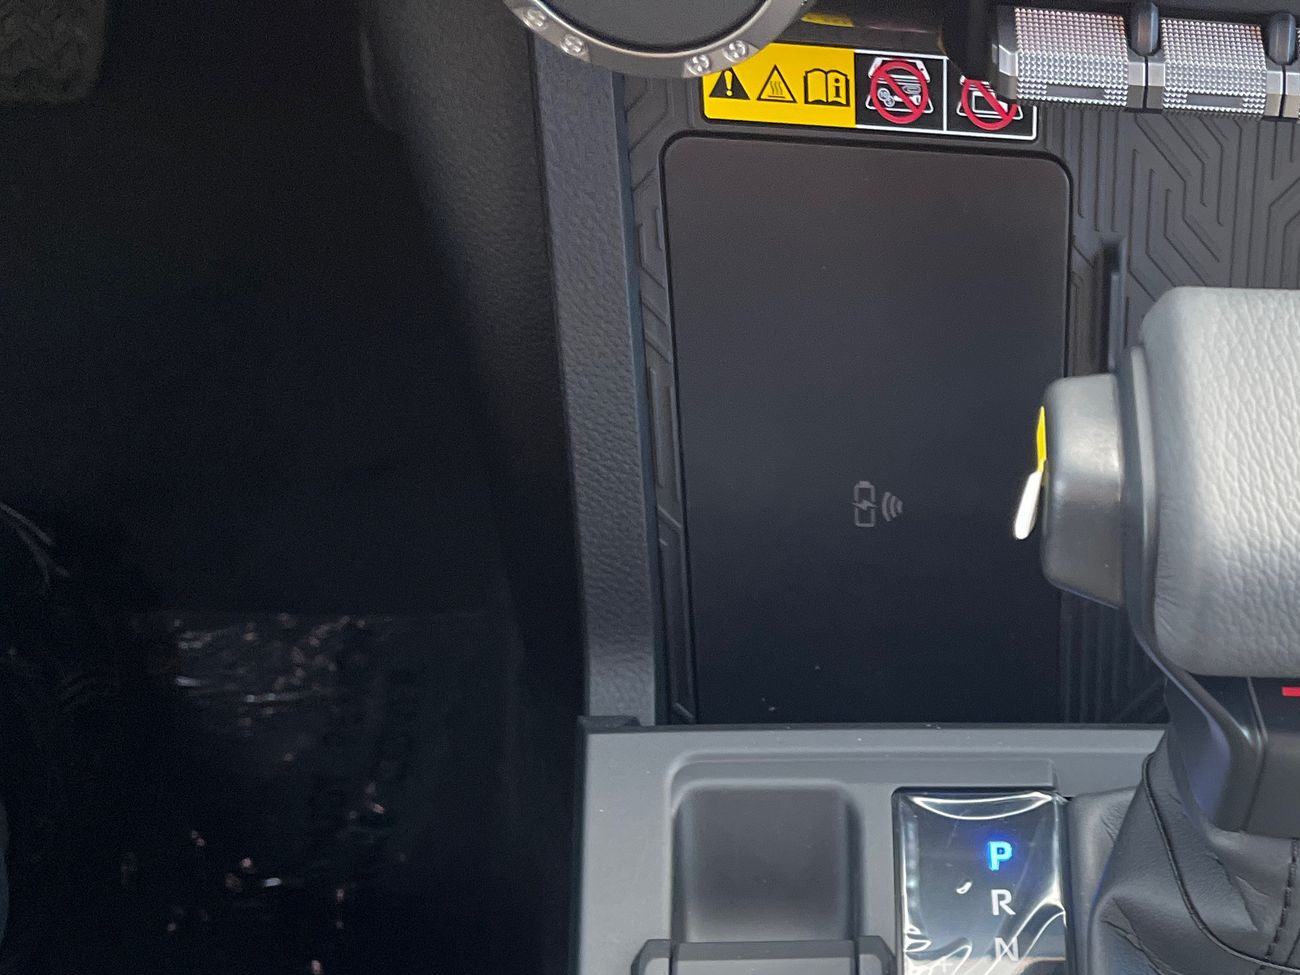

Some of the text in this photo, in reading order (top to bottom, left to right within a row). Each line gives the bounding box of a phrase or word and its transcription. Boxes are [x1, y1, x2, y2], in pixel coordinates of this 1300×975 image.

[987, 840, 1013, 871] P
[991, 889, 1016, 916] R
[994, 937, 1019, 961] N
